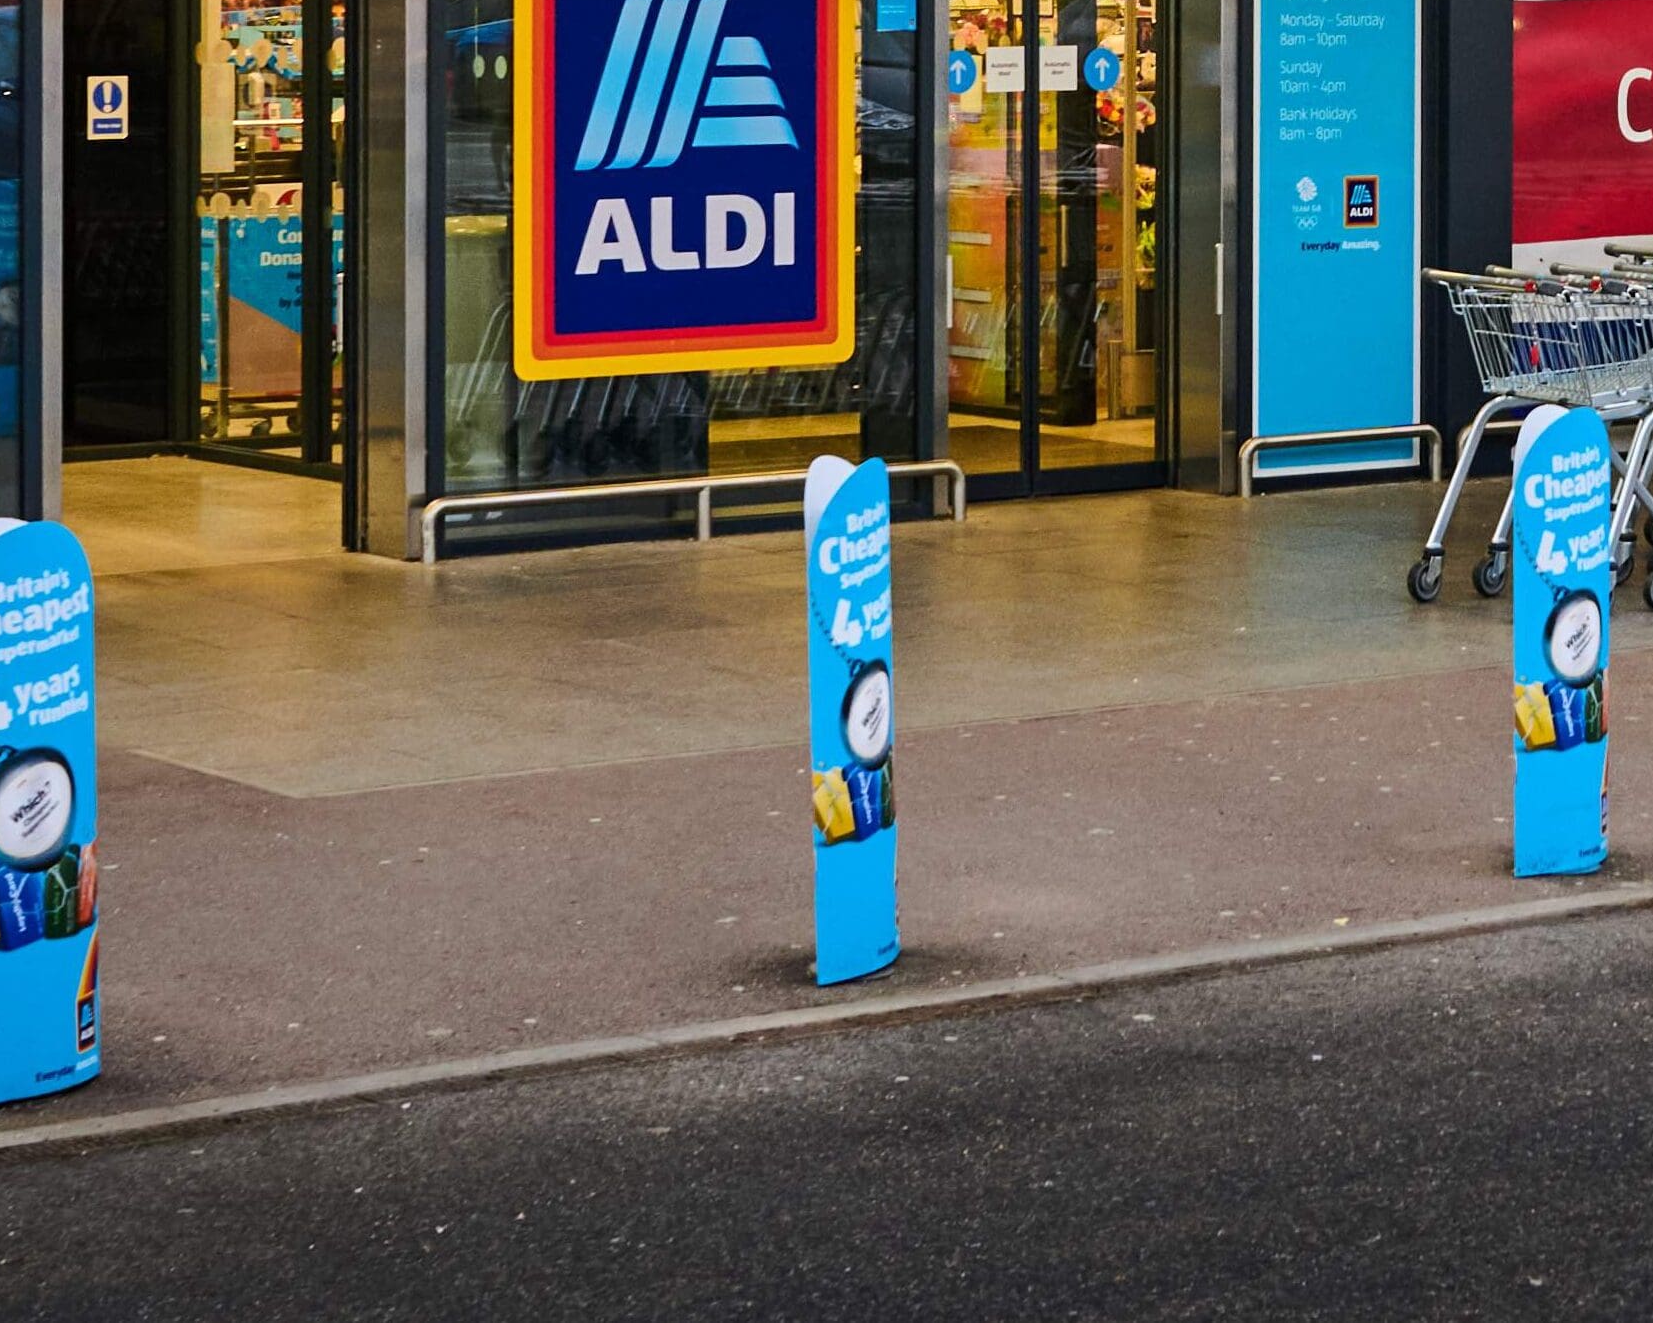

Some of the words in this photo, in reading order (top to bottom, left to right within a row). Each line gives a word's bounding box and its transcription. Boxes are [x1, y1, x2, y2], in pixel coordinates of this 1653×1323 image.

[1279, 13, 1326, 30] Monday
[1335, 13, 1385, 30] Saturday
[1279, 32, 1306, 46] 8am
[1316, 32, 1347, 47] 10pm
[1279, 60, 1323, 77] Sunday
[1279, 80, 1310, 94] 10am
[1320, 79, 1347, 95] 4pm
[1279, 107, 1308, 121] Bank
[1310, 106, 1357, 123] Holidays
[1279, 127, 1305, 141] 8am
[1315, 126, 1342, 142] 8pm
[1349, 206, 1374, 217] ALDI
[574, 192, 795, 275] ALDI
[1301, 241, 1340, 252] Everyday
[1536, 530, 1568, 576] 4
[830, 598, 863, 647] 4
[13, 664, 81, 715] years
